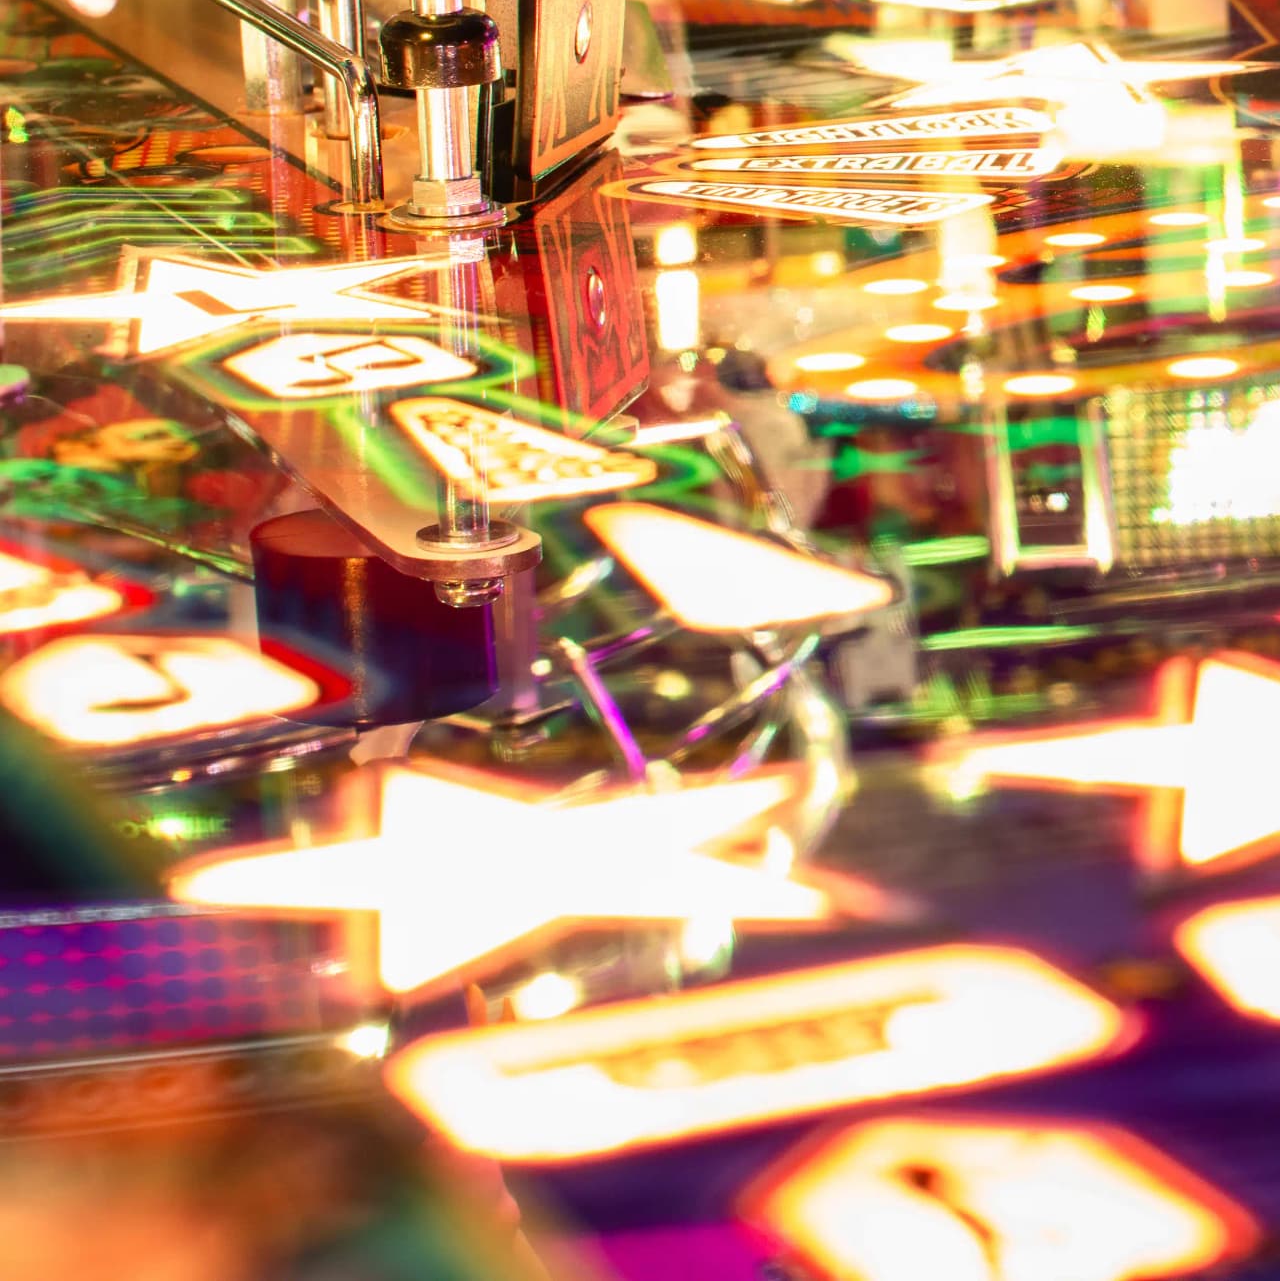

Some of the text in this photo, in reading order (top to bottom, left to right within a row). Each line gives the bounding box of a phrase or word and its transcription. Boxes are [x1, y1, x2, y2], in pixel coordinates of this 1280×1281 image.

[740, 153, 1034, 172] EXTRA BALL
[680, 184, 790, 200] TINY
